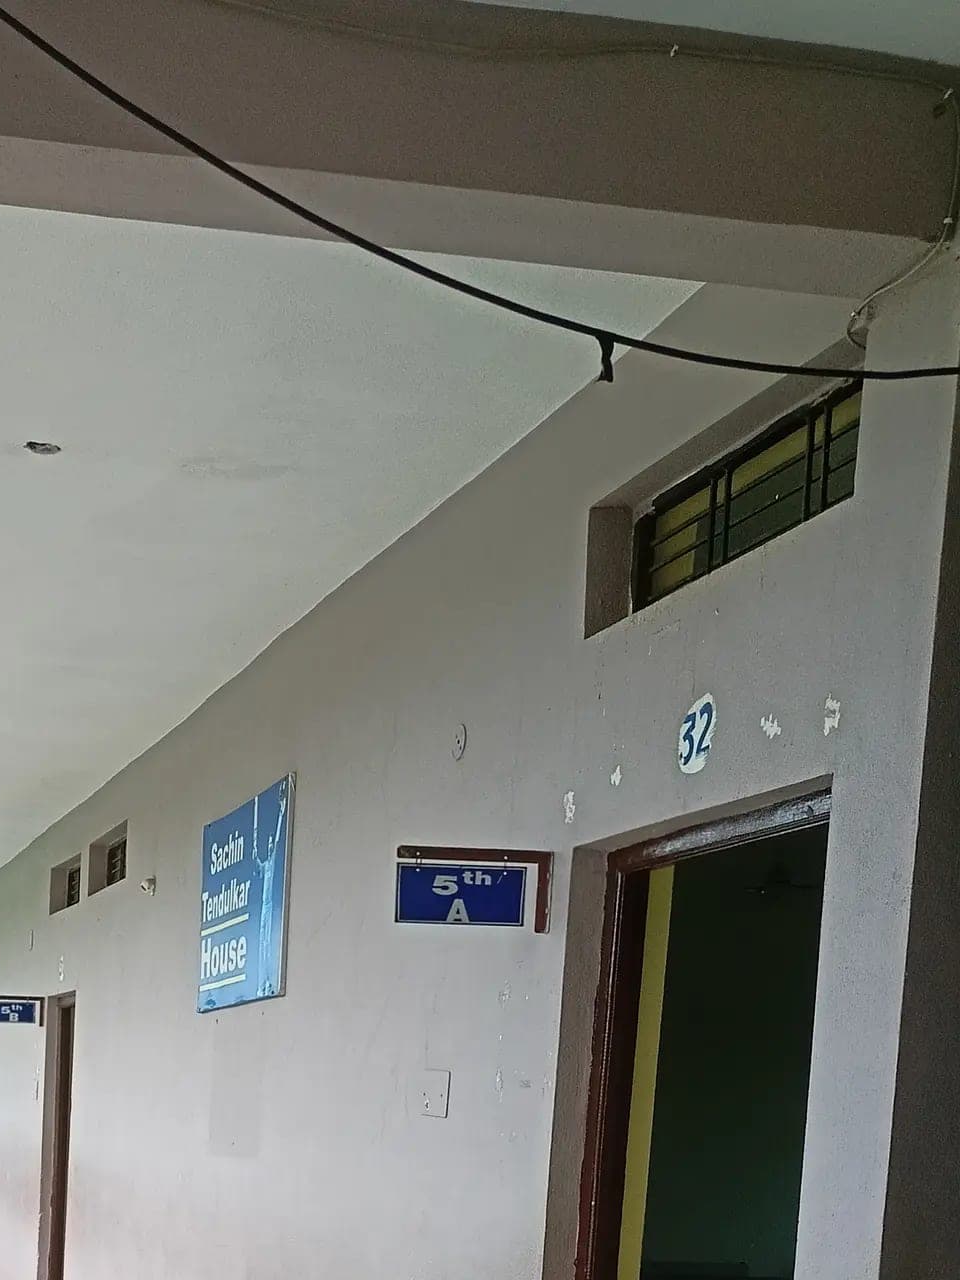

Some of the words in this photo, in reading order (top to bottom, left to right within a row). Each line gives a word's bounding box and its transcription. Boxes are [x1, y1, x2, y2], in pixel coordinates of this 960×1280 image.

[680, 702, 713, 766] 32
[210, 831, 244, 875] Sachin
[202, 878, 251, 922] Tendulkar
[431, 871, 492, 896] 5th
[446, 898, 471, 923] A
[200, 935, 248, 980] House
[1, 1004, 23, 1015] 5th
[9, 1012, 19, 1022] B
